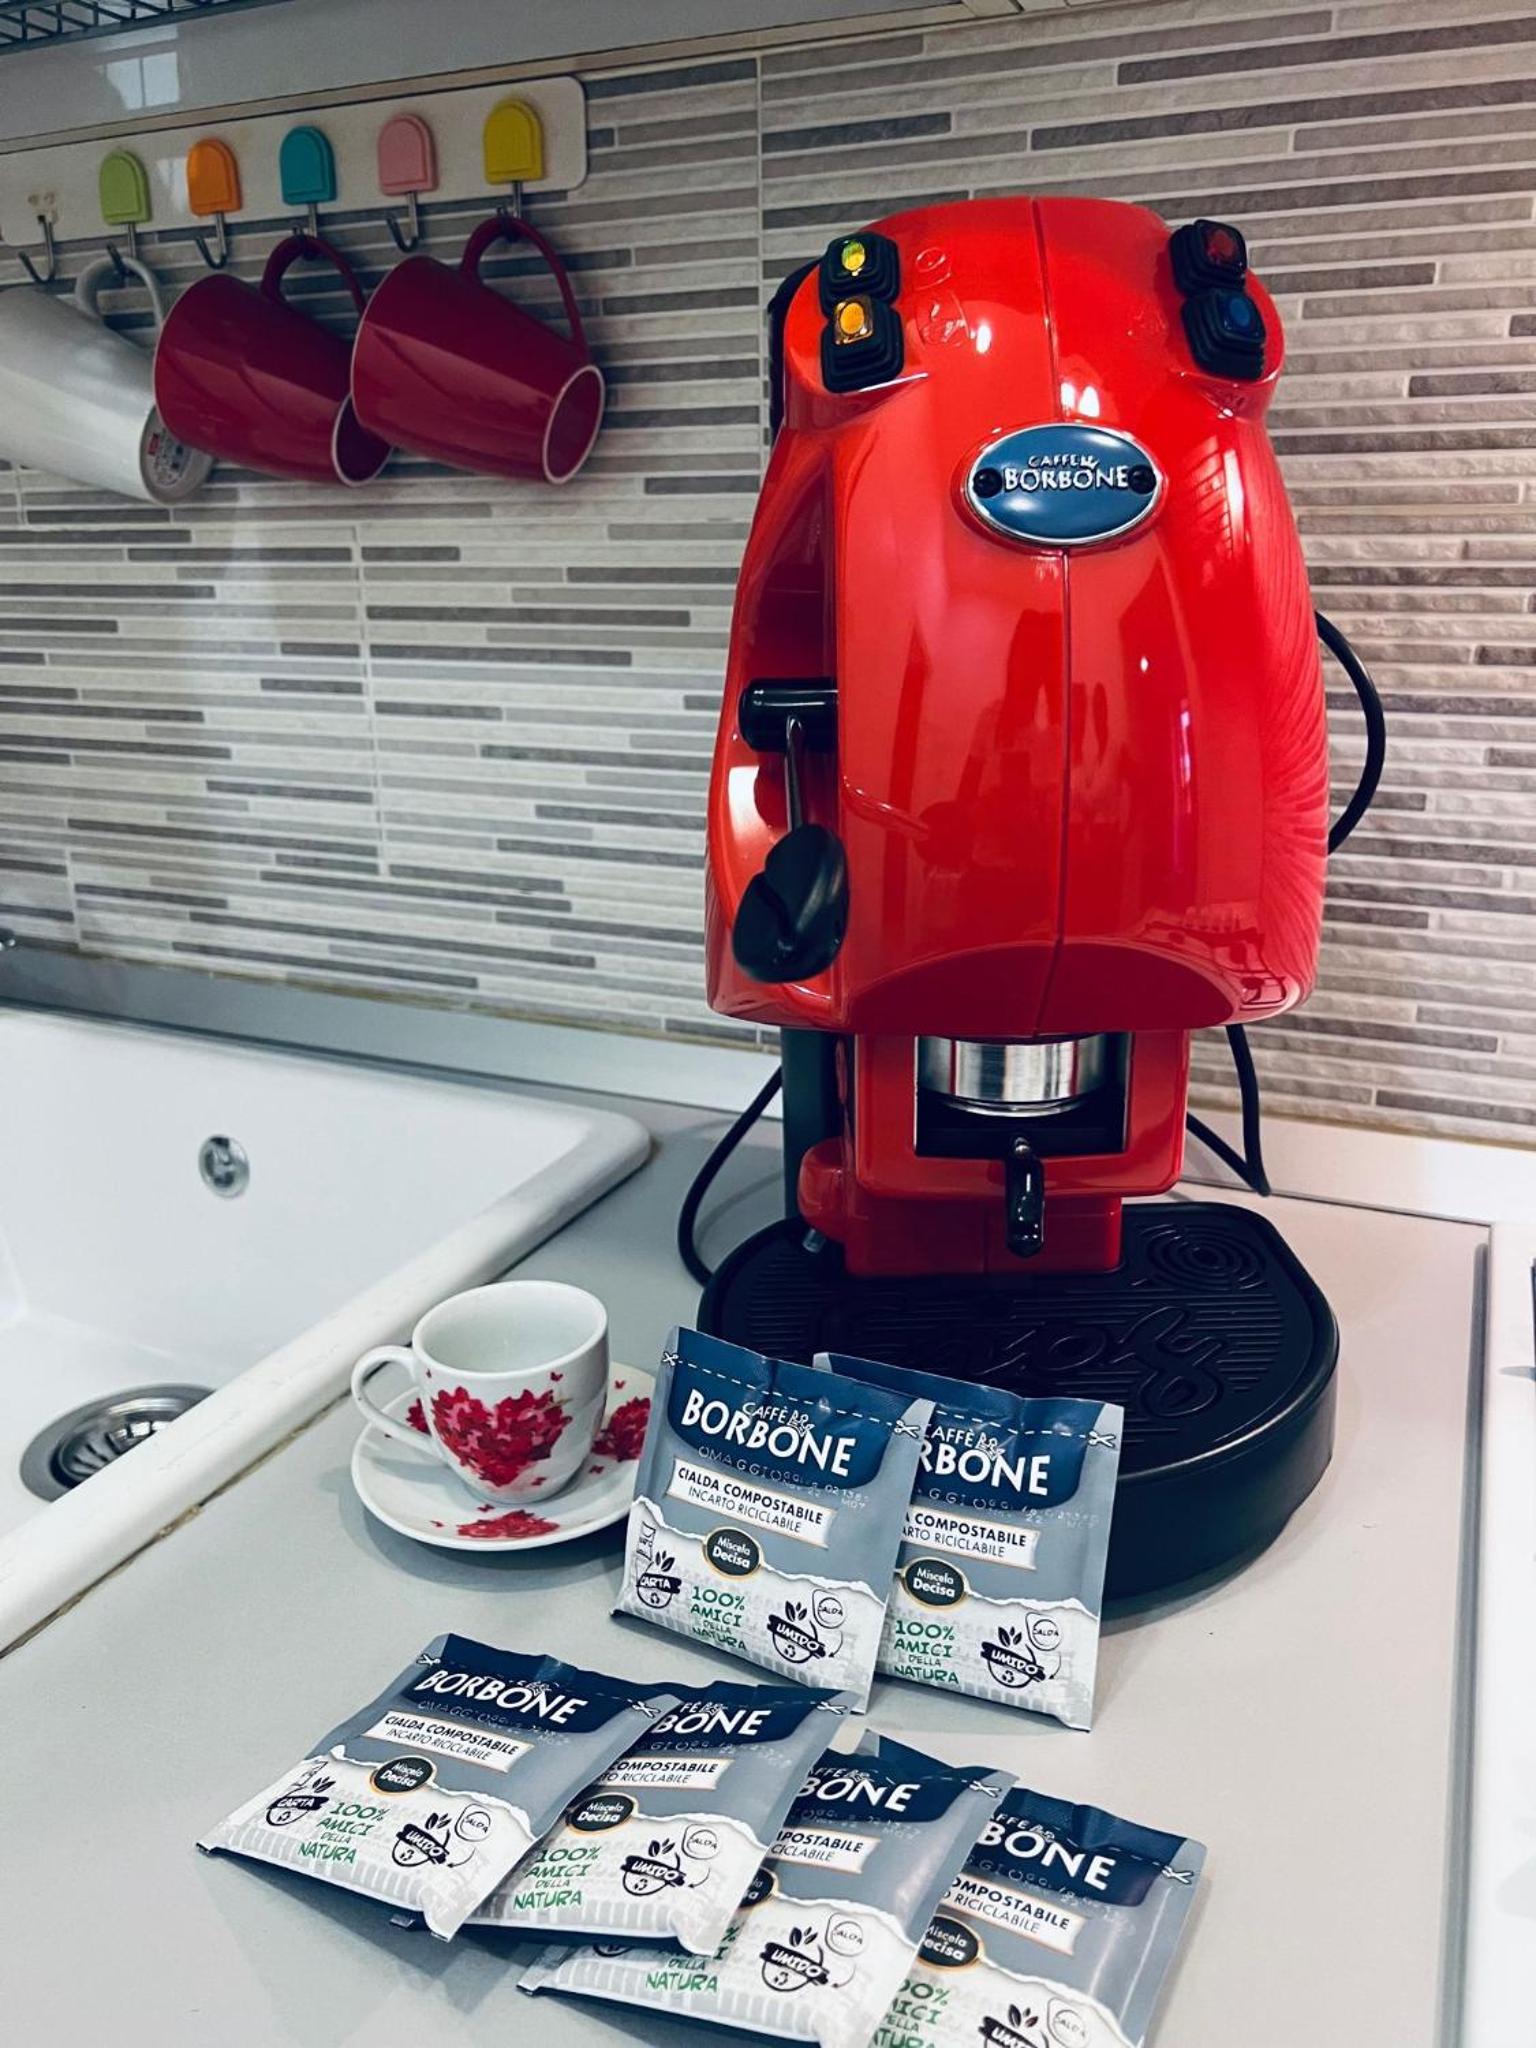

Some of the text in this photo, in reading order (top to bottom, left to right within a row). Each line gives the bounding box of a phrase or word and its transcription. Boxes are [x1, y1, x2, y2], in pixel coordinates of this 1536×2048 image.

[1004, 465, 1129, 491] BORBONE
[742, 1401, 788, 1424] CAFFÈ
[681, 1389, 856, 1477] BORBONE
[920, 1439, 1050, 1496] RBONE
[678, 1467, 719, 1491] CIALDA
[723, 1482, 823, 1525] COMPOSTABILE
[688, 1487, 801, 1532] INCARTO RICICLABILE
[915, 1512, 1027, 1547] COMPOSTABILE
[717, 1536, 751, 1555] Miscela
[934, 1532, 1005, 1558] RICICLABILE
[712, 1546, 750, 1569] Decisa
[640, 1576, 671, 1589] CARTA
[916, 1567, 954, 1585] Miscela
[692, 1586, 745, 1611] 100%
[913, 1578, 955, 1598] Decisa
[691, 1604, 742, 1627] AMICI
[703, 1620, 732, 1634] DELLA
[776, 1624, 820, 1651] UMIDO
[895, 1620, 955, 1640] 100%
[692, 1627, 748, 1651] NATURA
[894, 1638, 953, 1658] AMICI
[909, 1654, 941, 1667] DELLA
[990, 1649, 1037, 1675] UMIDO
[894, 1665, 959, 1685] NATURA
[414, 1670, 588, 1724] BORBONE
[650, 1710, 772, 1735] BONE
[385, 1715, 424, 1733] CIALDA
[426, 1724, 519, 1755] COMPOSTABILE
[386, 1728, 492, 1760] INCARTO RICICLABILE
[380, 1769, 417, 1787] Decisa
[622, 1773, 692, 1784] RICICLABILE
[796, 1778, 921, 1812] BONE
[330, 1802, 390, 1821] 100%
[576, 1811, 621, 1824] Decisa
[587, 1802, 624, 1813] Miscela
[316, 1817, 374, 1836] AMICI
[320, 1832, 351, 1844] DELLA
[406, 1829, 443, 1857] UMIDO
[776, 1831, 863, 1853] POSTABILE
[298, 1842, 356, 1863] NATURA
[535, 1846, 601, 1863] 100%
[770, 1844, 835, 1862] CICLABILE
[977, 1820, 1116, 1891] BONE
[526, 1864, 591, 1879] AMICI
[632, 1859, 676, 1882] UMIDO
[535, 1879, 571, 1889] DELLA
[513, 1890, 582, 1909] NATURA
[952, 1877, 1070, 1930] MPOSTABILE
[955, 1893, 1041, 1934] RICICLABILE
[923, 1940, 966, 1961] ecisa
[668, 1958, 706, 1971] DELLA
[772, 1949, 819, 1979] UMIDO
[646, 1973, 717, 1991] NATURA
[885, 2013, 919, 2032] ELLA
